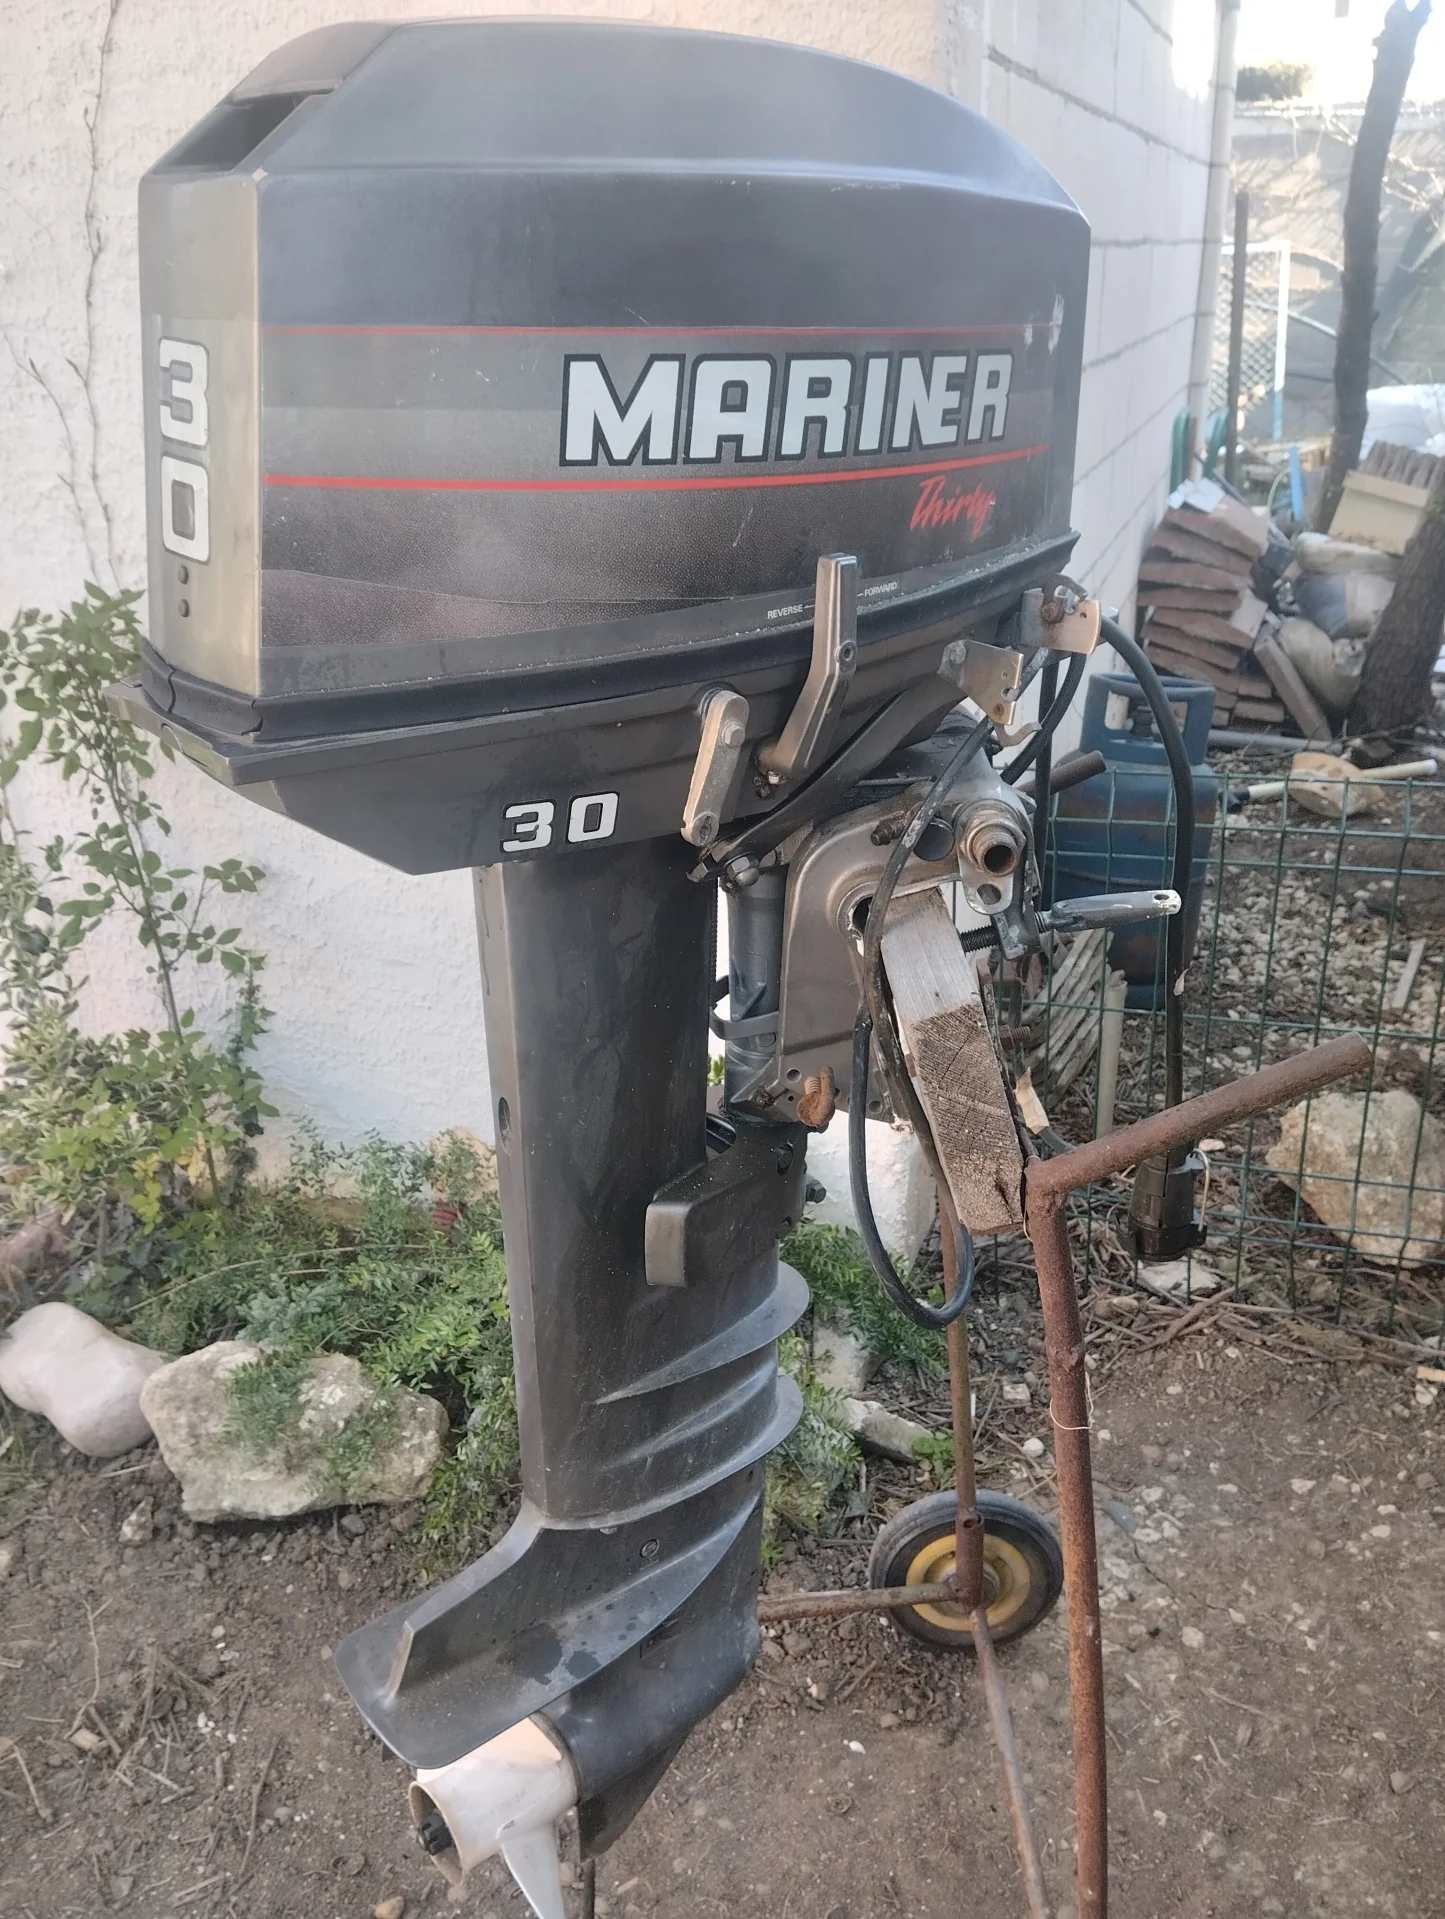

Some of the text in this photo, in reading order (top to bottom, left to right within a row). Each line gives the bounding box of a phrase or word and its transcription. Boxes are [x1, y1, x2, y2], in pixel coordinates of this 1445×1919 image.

[559, 349, 1013, 466] MARINER
[159, 337, 210, 564] 30
[910, 475, 995, 536] Thirty
[767, 581, 898, 619] REVERSE FORWARD
[501, 790, 619, 853] 30
